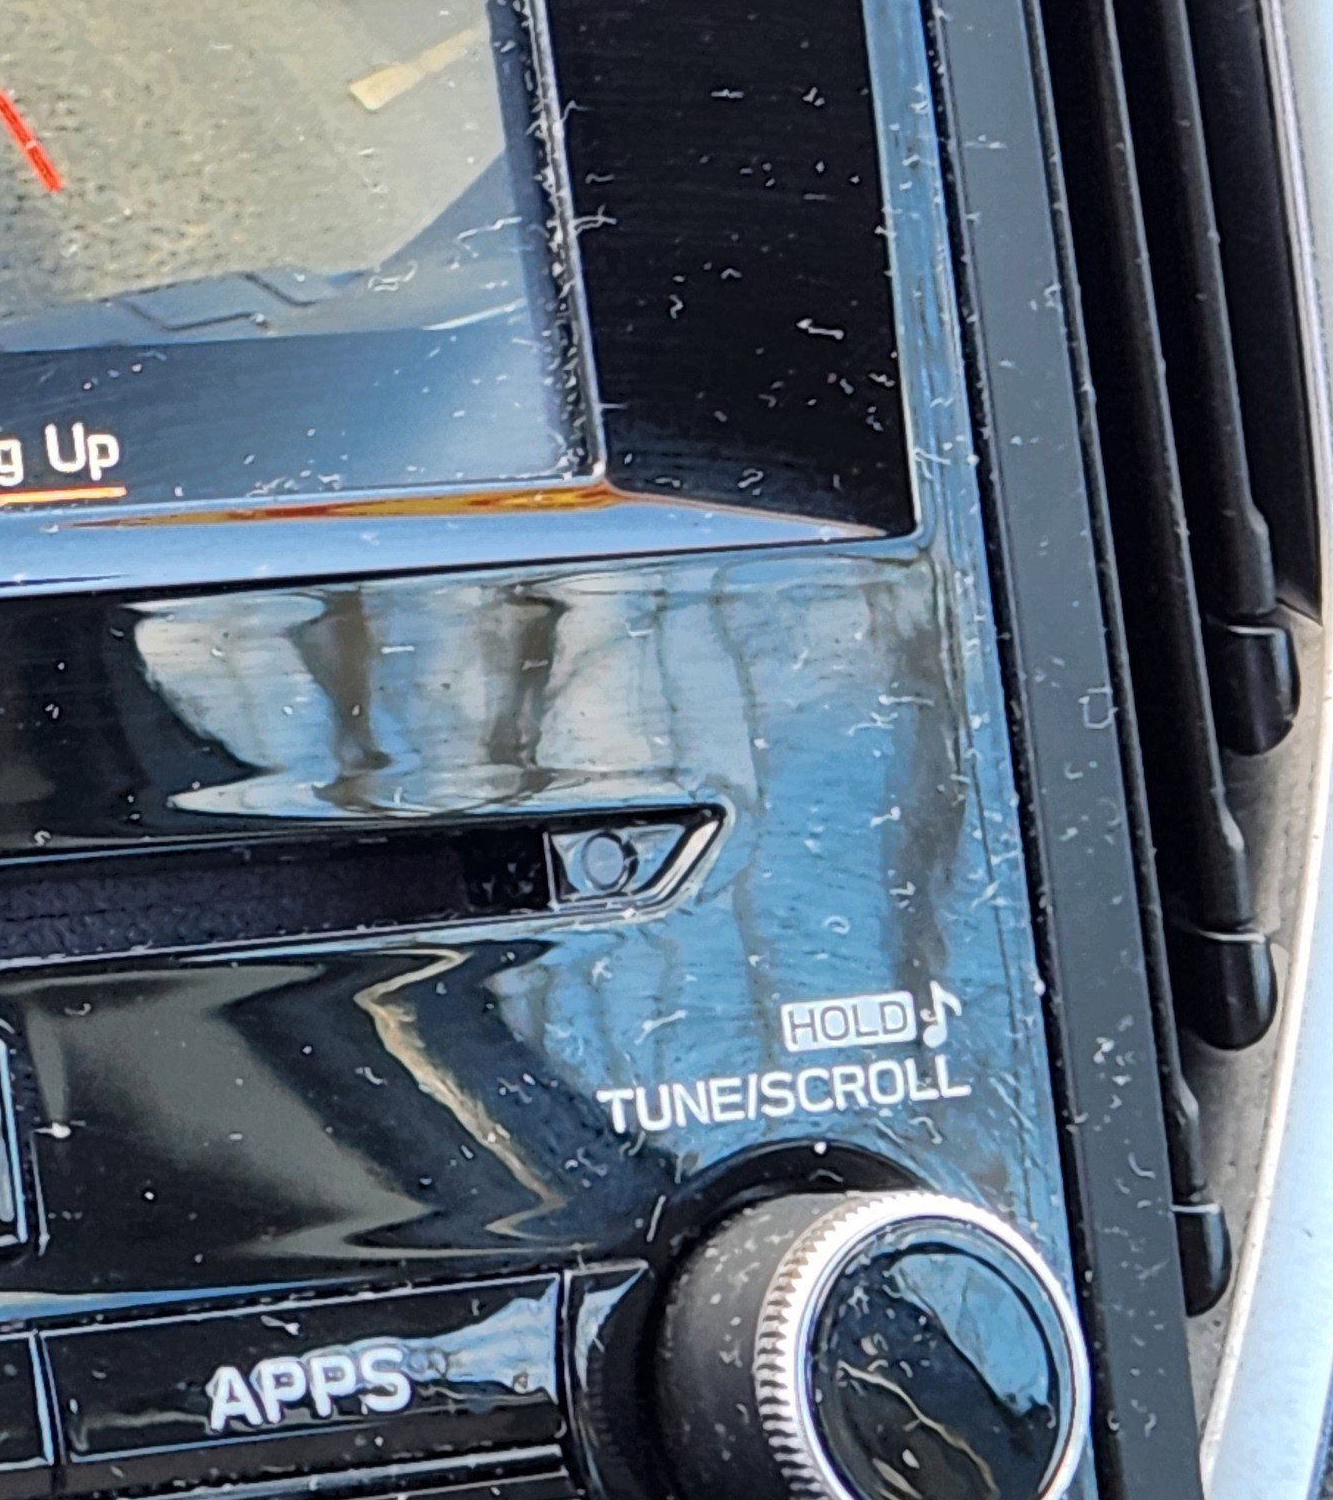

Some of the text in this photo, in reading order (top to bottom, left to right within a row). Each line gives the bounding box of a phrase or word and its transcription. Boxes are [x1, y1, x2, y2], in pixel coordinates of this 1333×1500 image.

[44, 422, 121, 481] Up
[786, 999, 910, 1046] HOLD
[596, 1053, 973, 1135] TUNE/SCROLL
[209, 1346, 412, 1432] APPS
